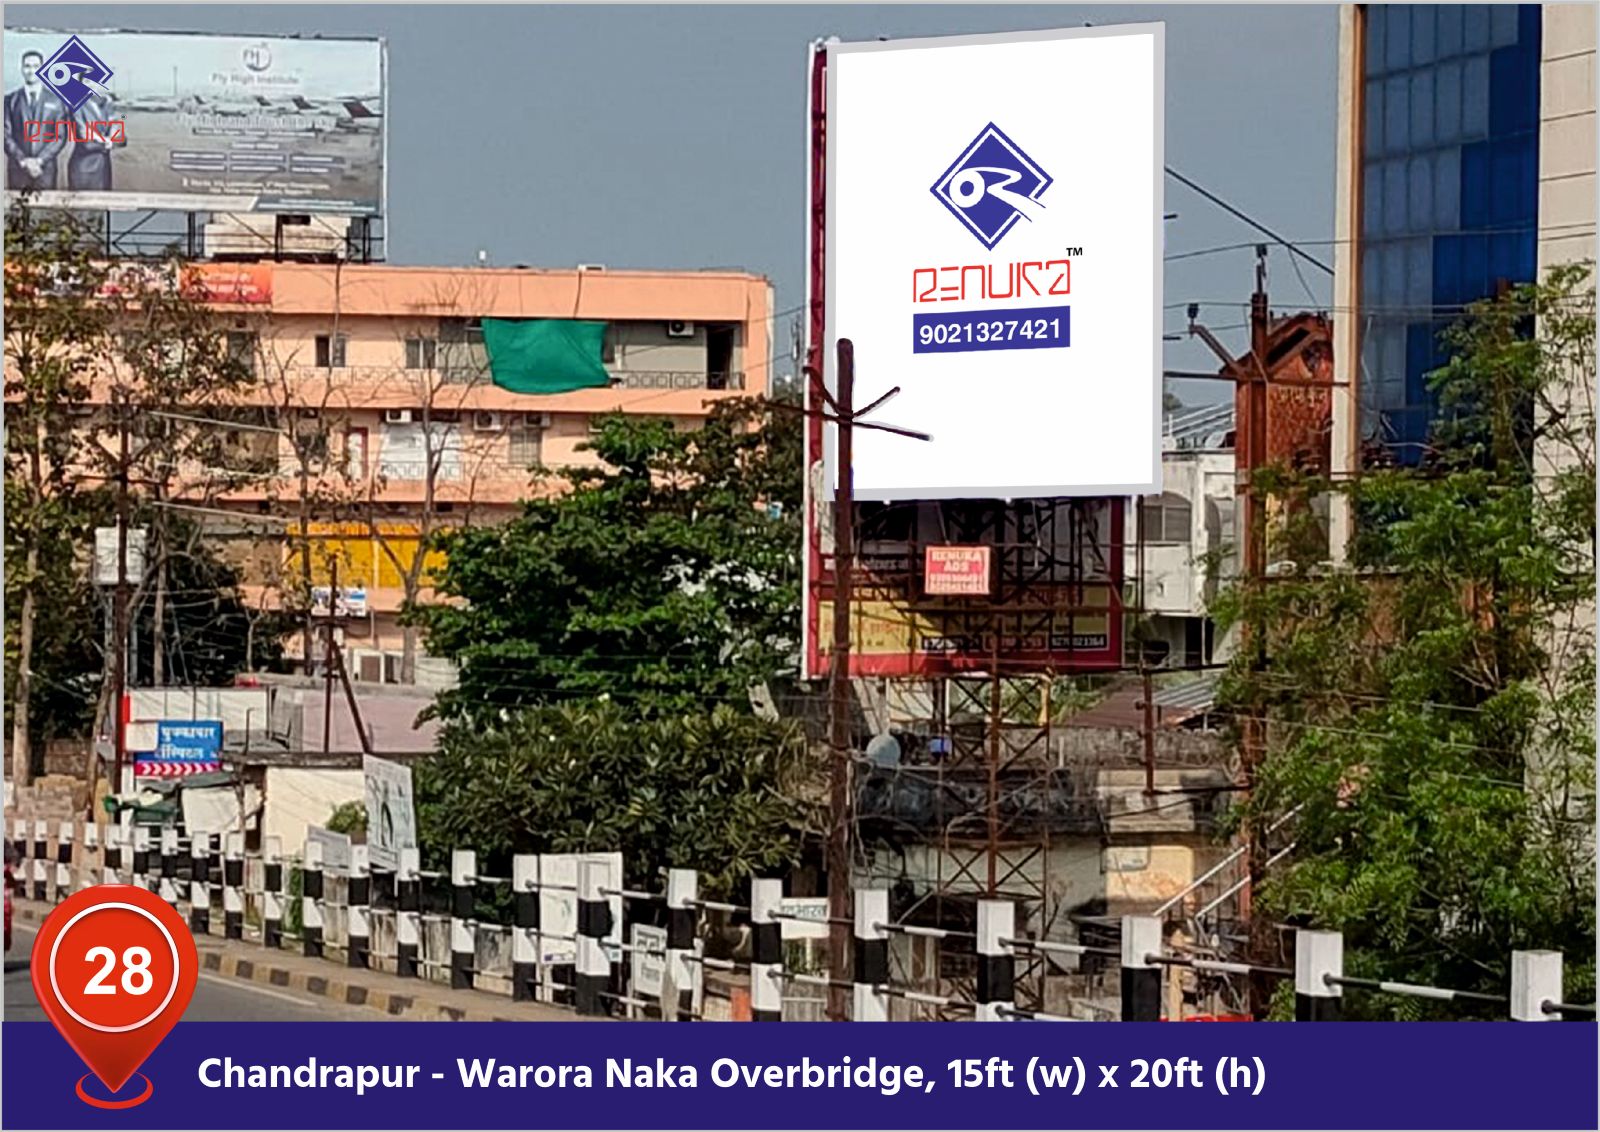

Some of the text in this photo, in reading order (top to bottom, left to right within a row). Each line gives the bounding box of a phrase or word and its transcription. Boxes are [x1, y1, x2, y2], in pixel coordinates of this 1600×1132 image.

[231, 74, 254, 85] High
[1066, 247, 1083, 257] TM
[919, 319, 1060, 345] 9021327421
[931, 550, 982, 561] RENUKA
[944, 561, 970, 572] ADS
